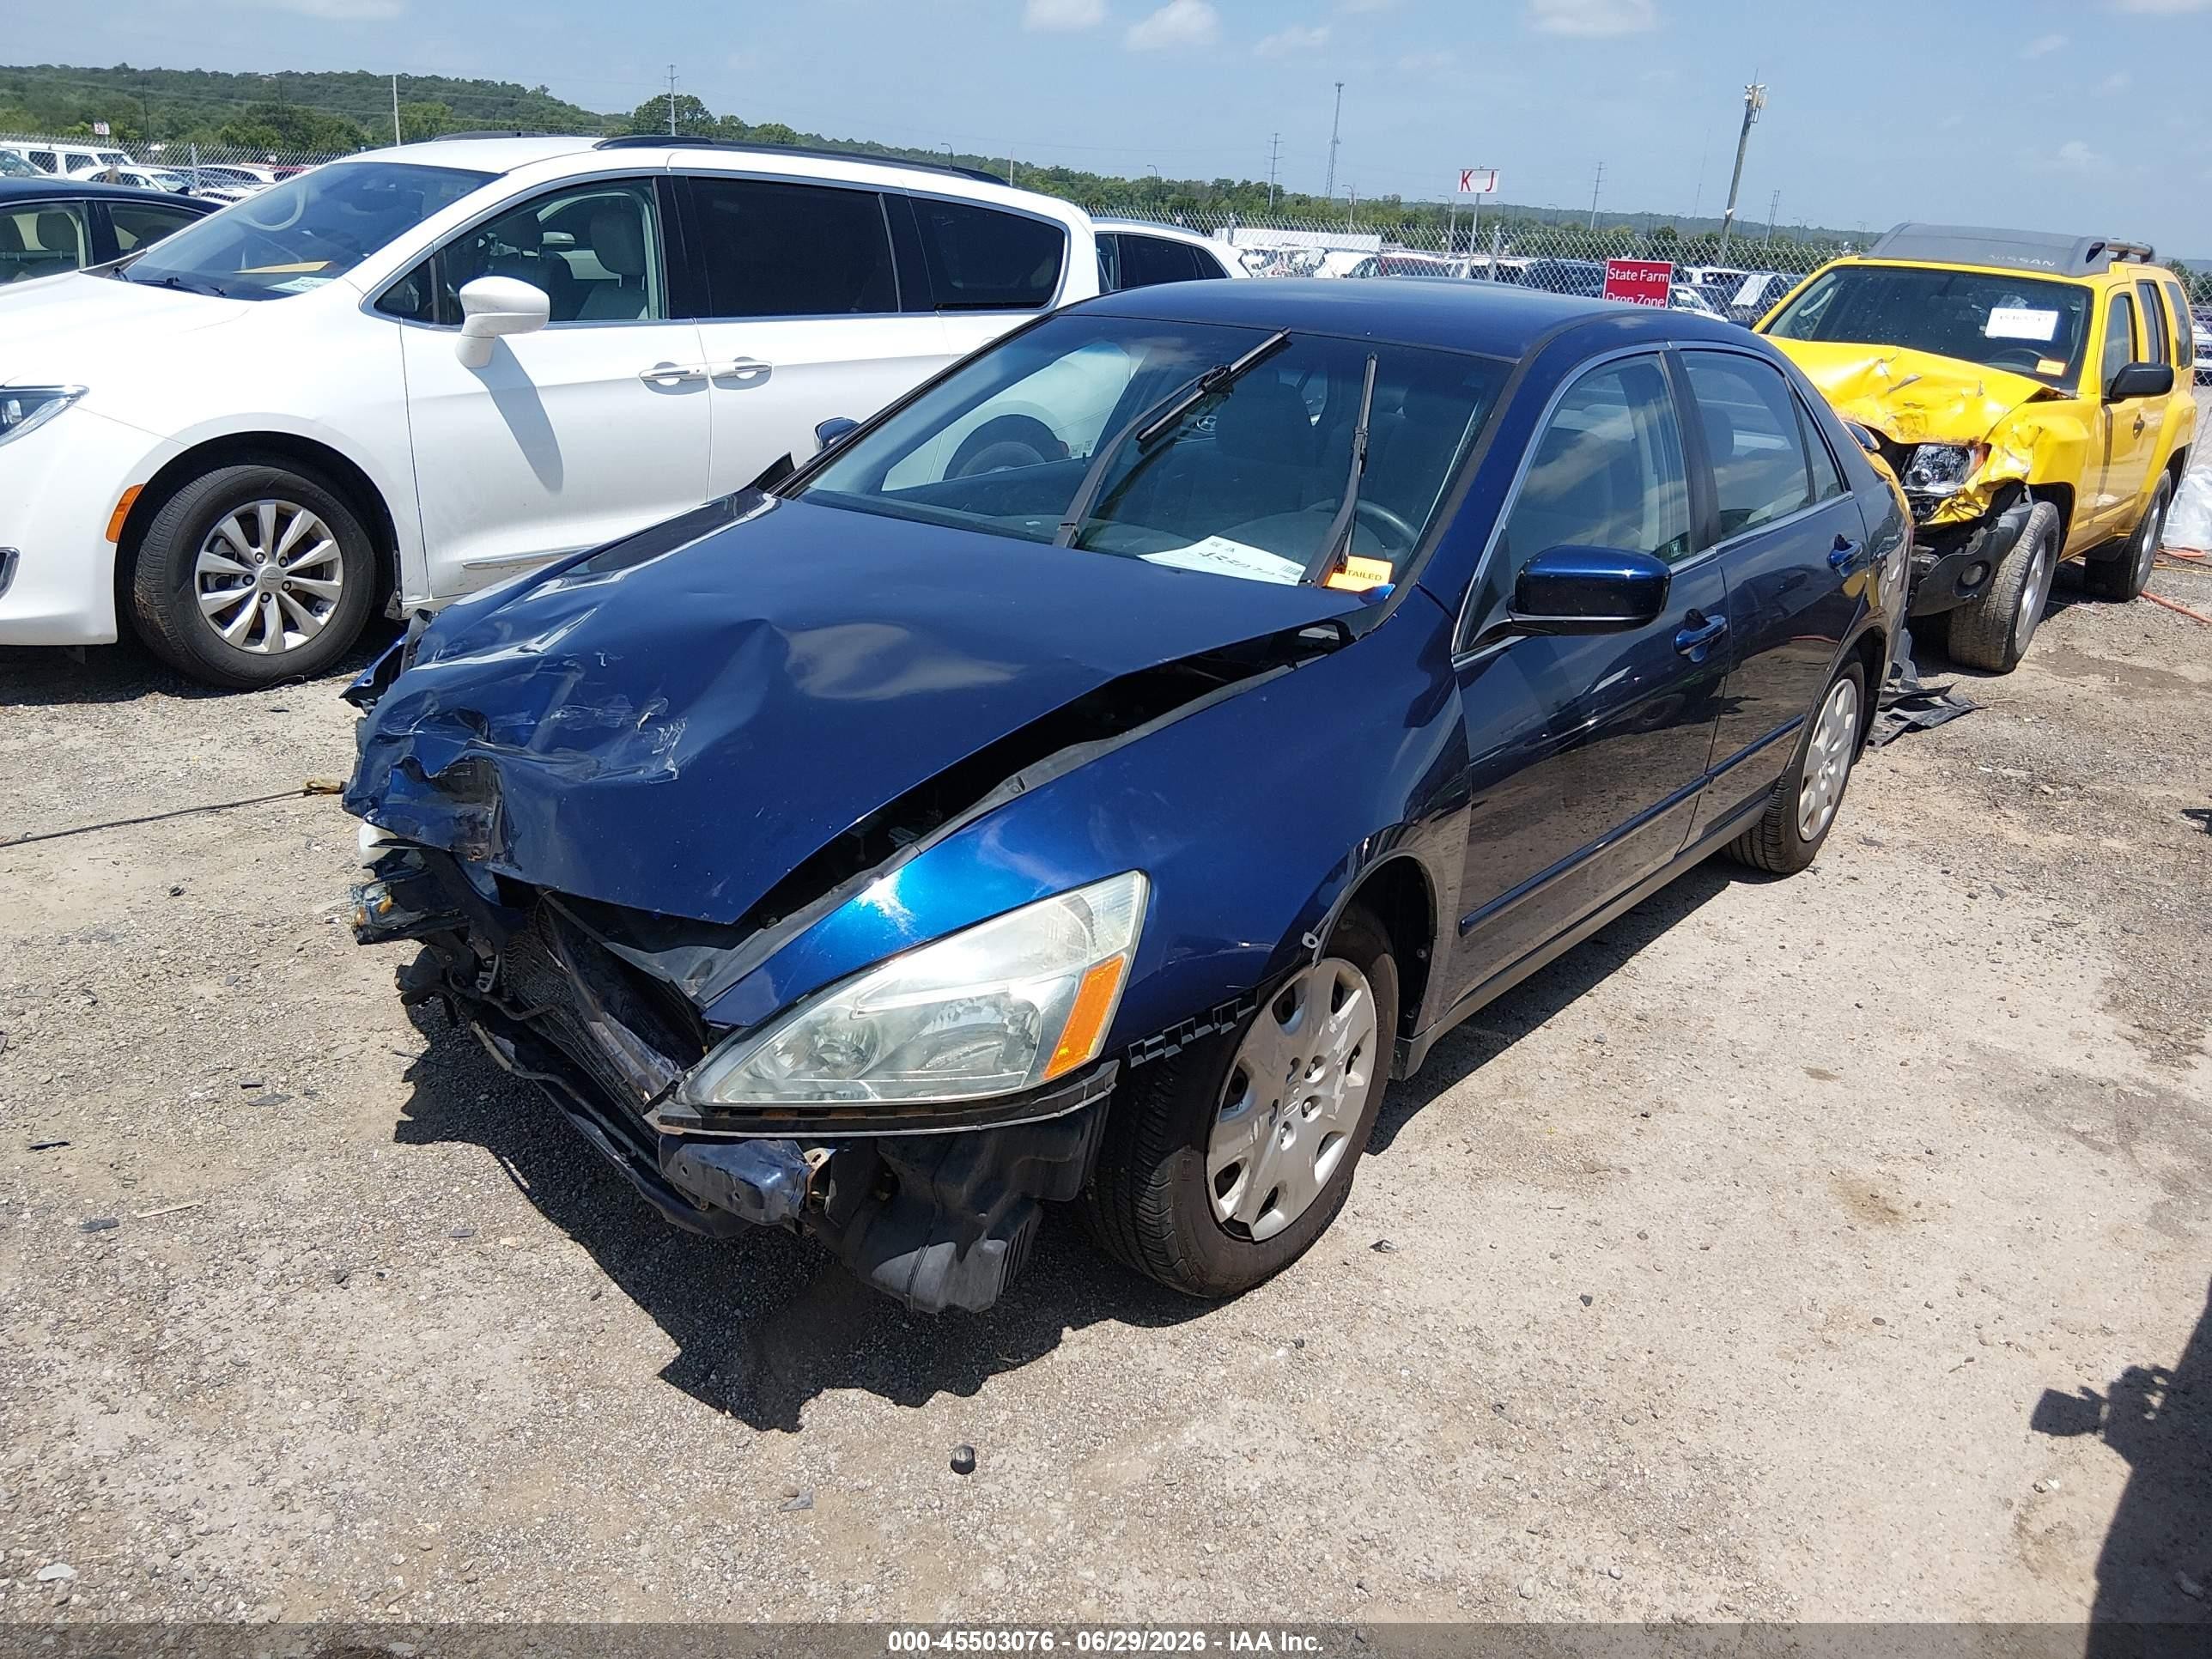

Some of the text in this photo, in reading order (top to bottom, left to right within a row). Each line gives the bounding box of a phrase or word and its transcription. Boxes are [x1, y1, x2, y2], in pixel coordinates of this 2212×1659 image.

[1460, 170, 1495, 192] K J
[1987, 253, 2056, 268] NISSAN
[1608, 267, 1669, 283] State Farm
[1635, 294, 1665, 308] Zone
